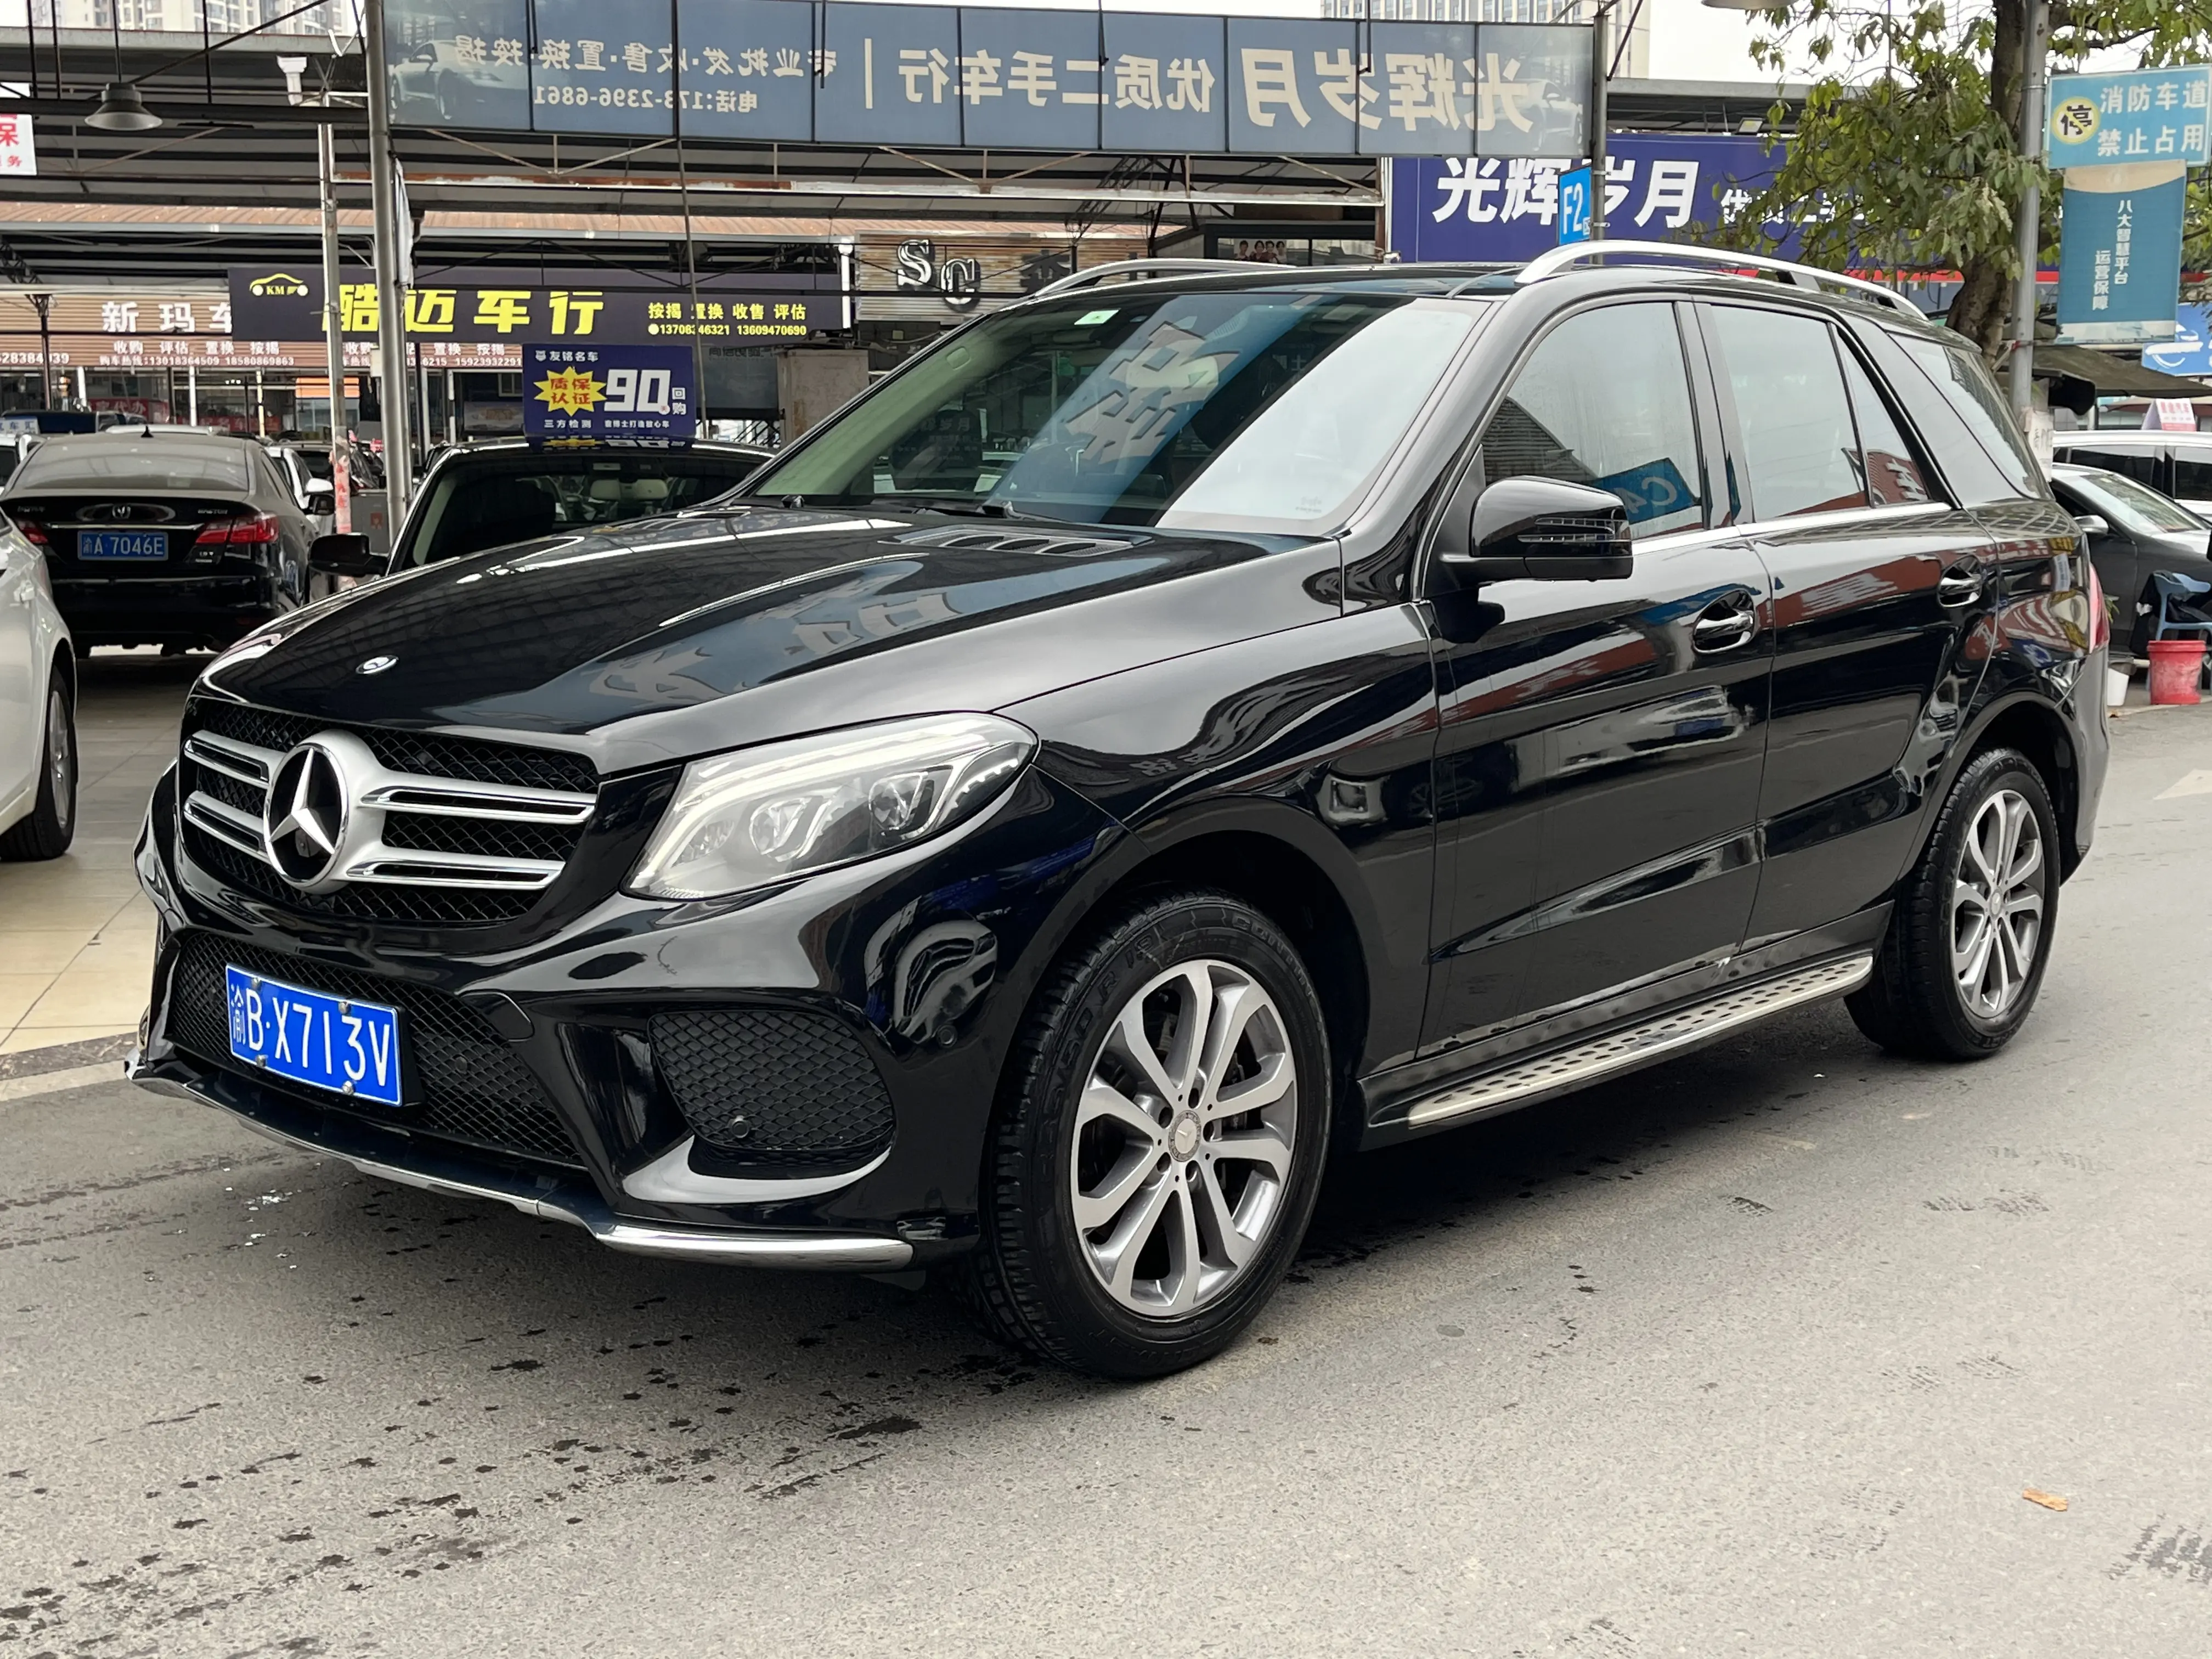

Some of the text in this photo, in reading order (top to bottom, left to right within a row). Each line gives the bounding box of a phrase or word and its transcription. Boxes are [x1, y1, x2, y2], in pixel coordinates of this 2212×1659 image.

[2100, 81, 2208, 114] 消防车道
[2060, 105, 2092, 136] 停
[2097, 124, 2205, 157] 禁止占用
[1564, 182, 1583, 235] F2
[266, 285, 285, 295] KM
[648, 302, 806, 321] 按揭 置换 收售 评估
[737, 325, 807, 336] 13609470690
[114, 340, 280, 356] 收购 评估 置换 按揭
[0, 352, 69, 364] 2838439
[550, 377, 591, 391] 质保
[604, 369, 671, 412] 90
[550, 392, 591, 405] 认证
